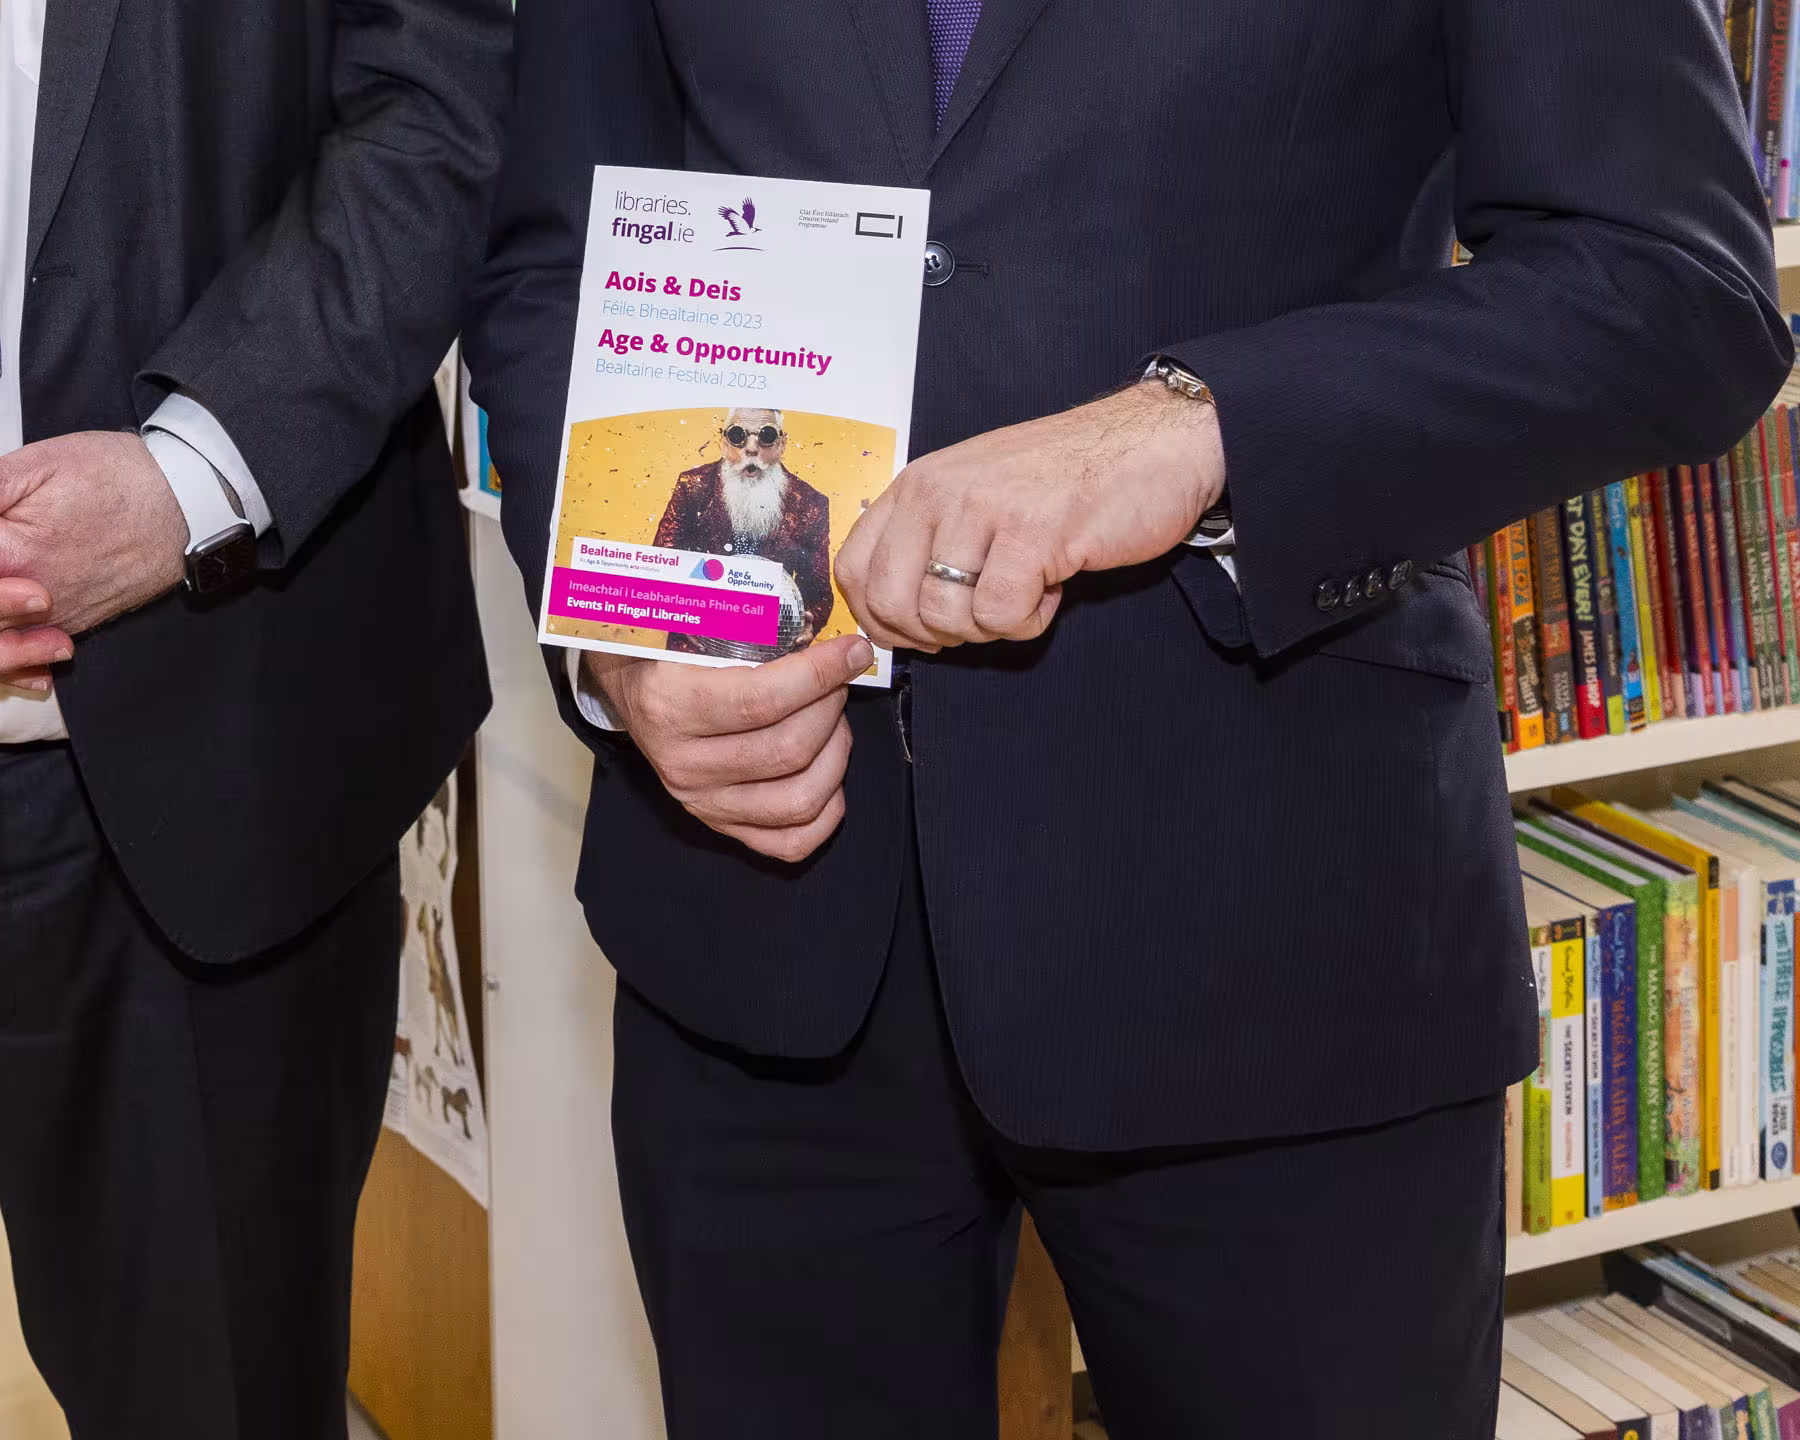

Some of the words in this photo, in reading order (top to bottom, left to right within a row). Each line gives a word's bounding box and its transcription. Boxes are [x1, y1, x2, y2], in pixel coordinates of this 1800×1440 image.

[614, 190, 692, 216] libraries.
[611, 217, 695, 245] fingal.ie
[604, 270, 657, 294] Aois
[663, 275, 682, 296] &
[688, 278, 742, 302] Deis
[602, 299, 635, 318] Féile
[639, 303, 719, 326] Bhealtaine
[723, 311, 763, 330] 2023
[598, 328, 644, 356] Age
[650, 333, 670, 354] &
[676, 336, 834, 377] Opportunity
[595, 358, 664, 380] Bealtaine
[668, 365, 724, 387] Festival
[727, 372, 768, 391] 2023
[580, 544, 632, 561] Bealtaine
[635, 552, 680, 568] Festival
[1567, 520, 1588, 562] DAY
[727, 577, 775, 592] Opportunity
[728, 568, 743, 579] Age
[743, 571, 751, 580] &
[630, 589, 707, 609] Leabharlanna
[709, 599, 740, 614] Fhine
[742, 604, 764, 617] Gall
[1573, 563, 1595, 621] EVER!
[566, 596, 603, 612] Events
[604, 601, 615, 613] in
[617, 603, 650, 620] Fingal
[652, 608, 701, 625] Libraries
[1579, 630, 1597, 664] JAMES
[1647, 968, 1659, 1025] MAGIC
[1647, 1029, 1659, 1107] FARAWAY
